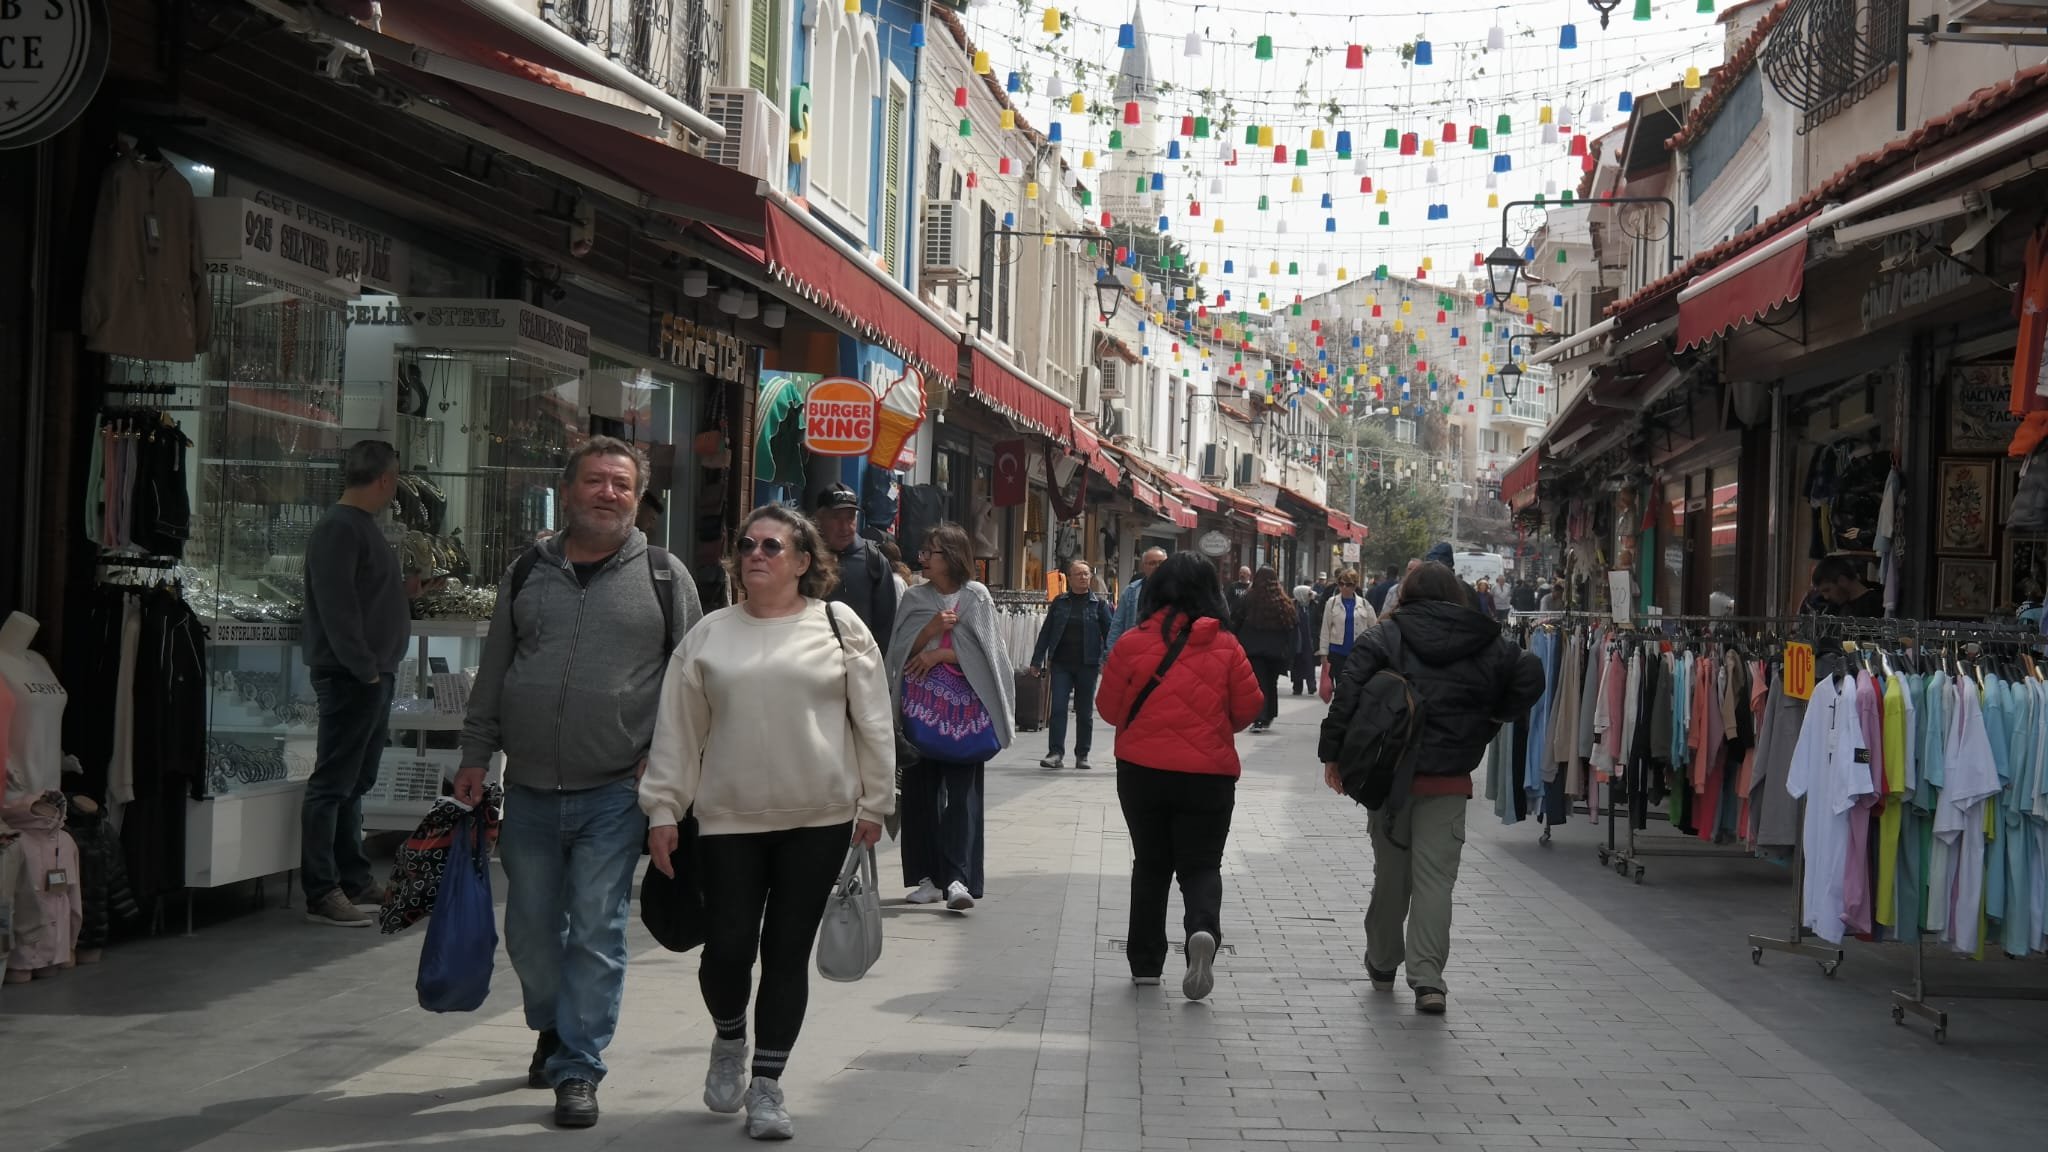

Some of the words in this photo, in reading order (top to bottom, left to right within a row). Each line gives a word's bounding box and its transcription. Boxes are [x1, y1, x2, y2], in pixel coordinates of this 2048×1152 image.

[245, 210, 273, 253] 925
[280, 223, 329, 274] SILVER
[336, 245, 361, 283] 925
[427, 305, 506, 328] STEEL
[809, 403, 871, 418] BURGER
[808, 417, 871, 439] KING
